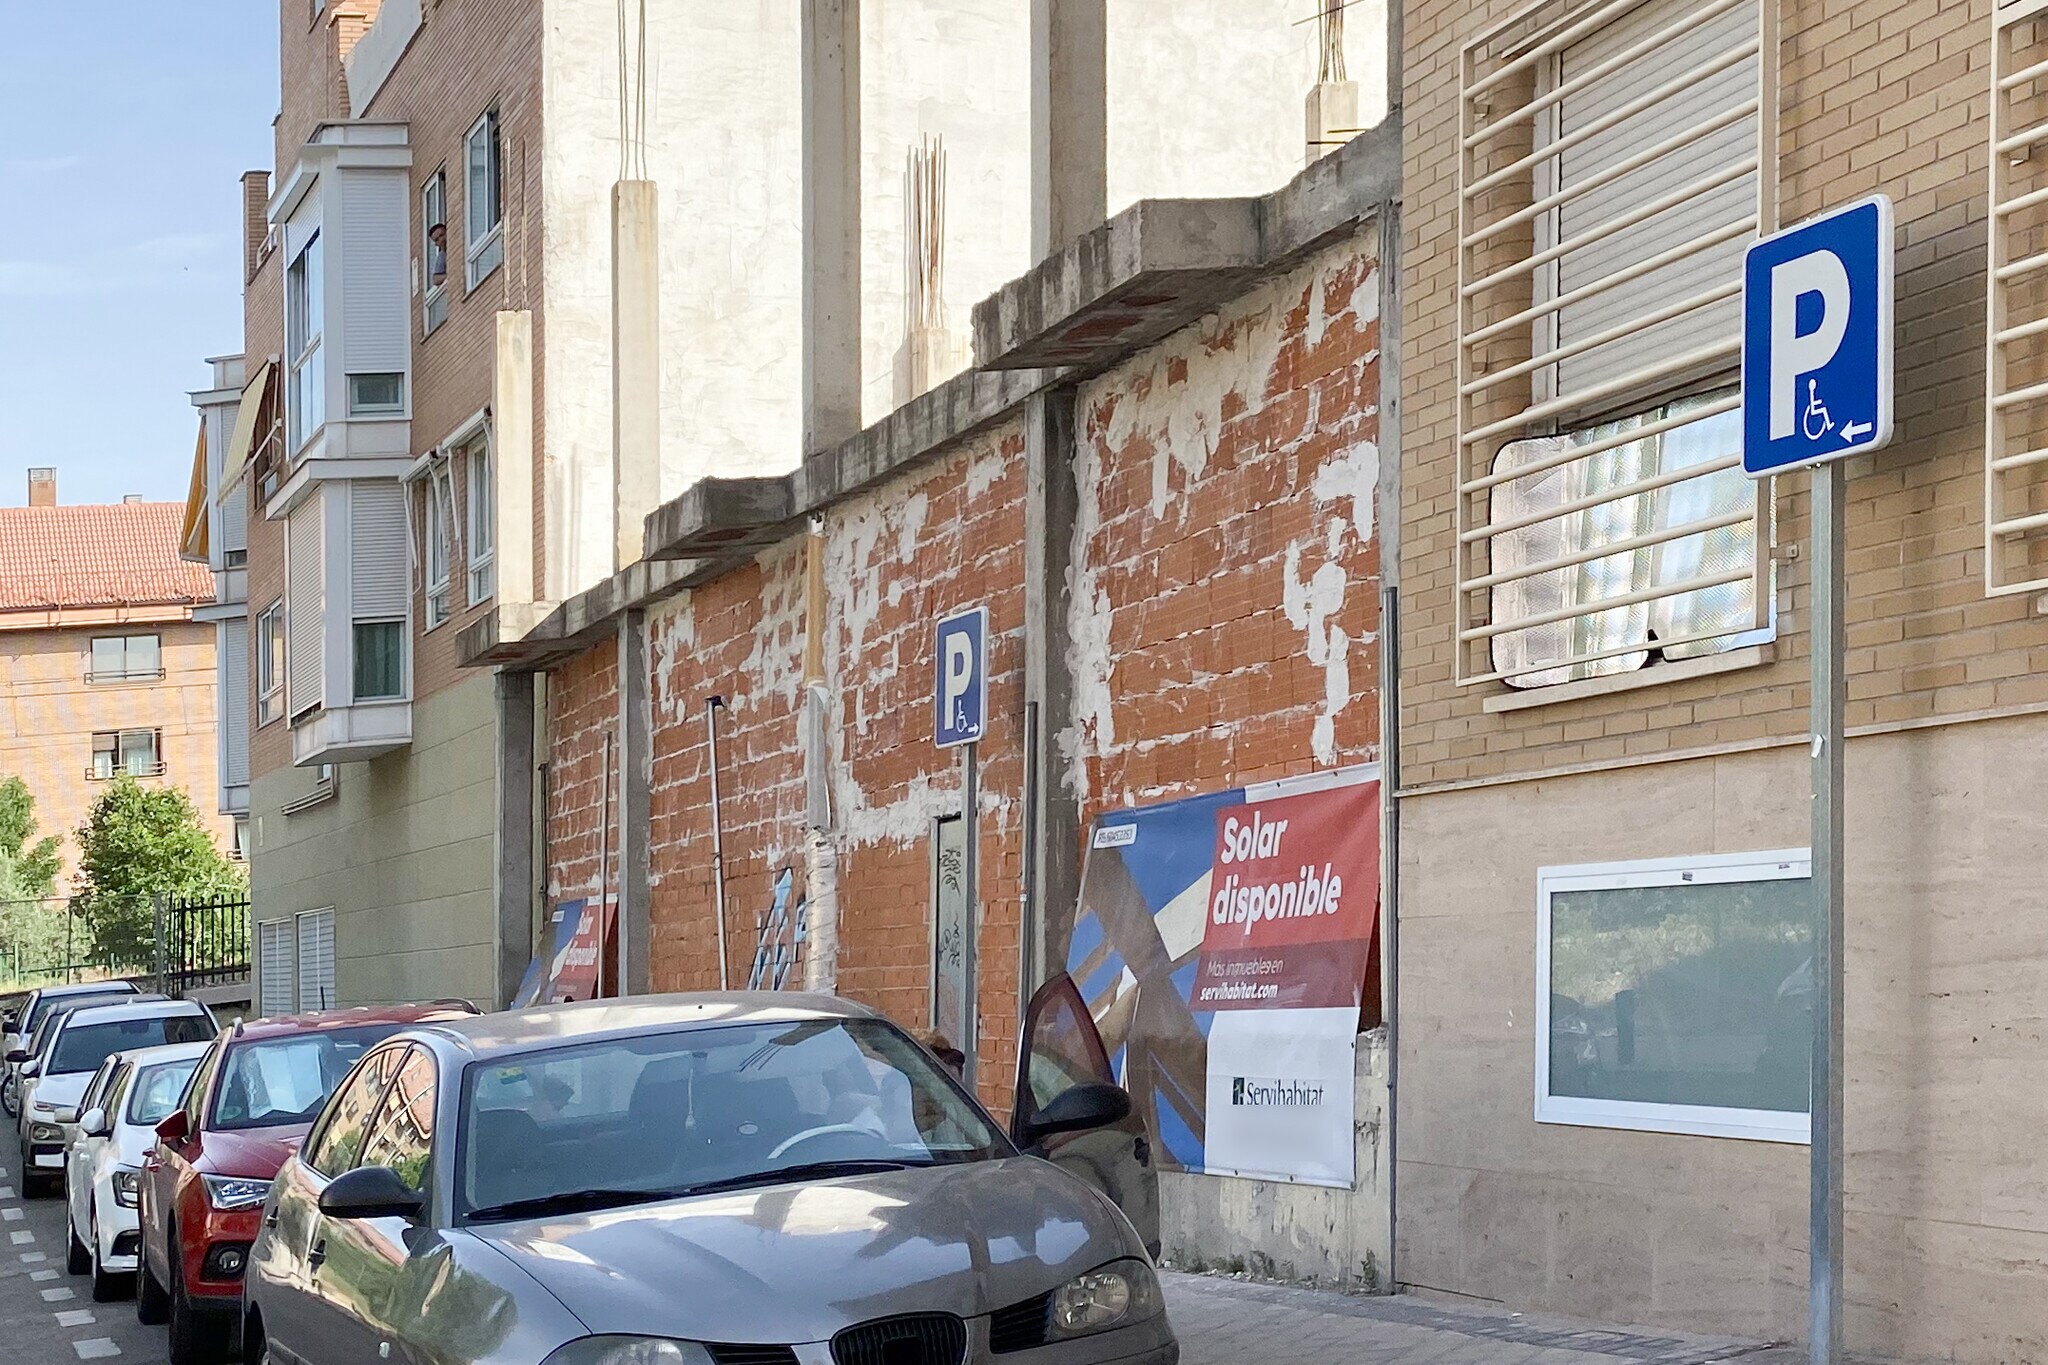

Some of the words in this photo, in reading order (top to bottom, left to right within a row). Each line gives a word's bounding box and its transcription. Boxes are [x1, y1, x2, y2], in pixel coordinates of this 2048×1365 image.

[1769, 249, 1851, 441] P
[944, 630, 973, 731] P
[1221, 810, 1289, 864] Solar
[1213, 862, 1342, 935] disponible
[1200, 981, 1279, 1001] servihabitat.com
[1271, 959, 1284, 975] en
[1246, 1078, 1324, 1106] Servihabitat
